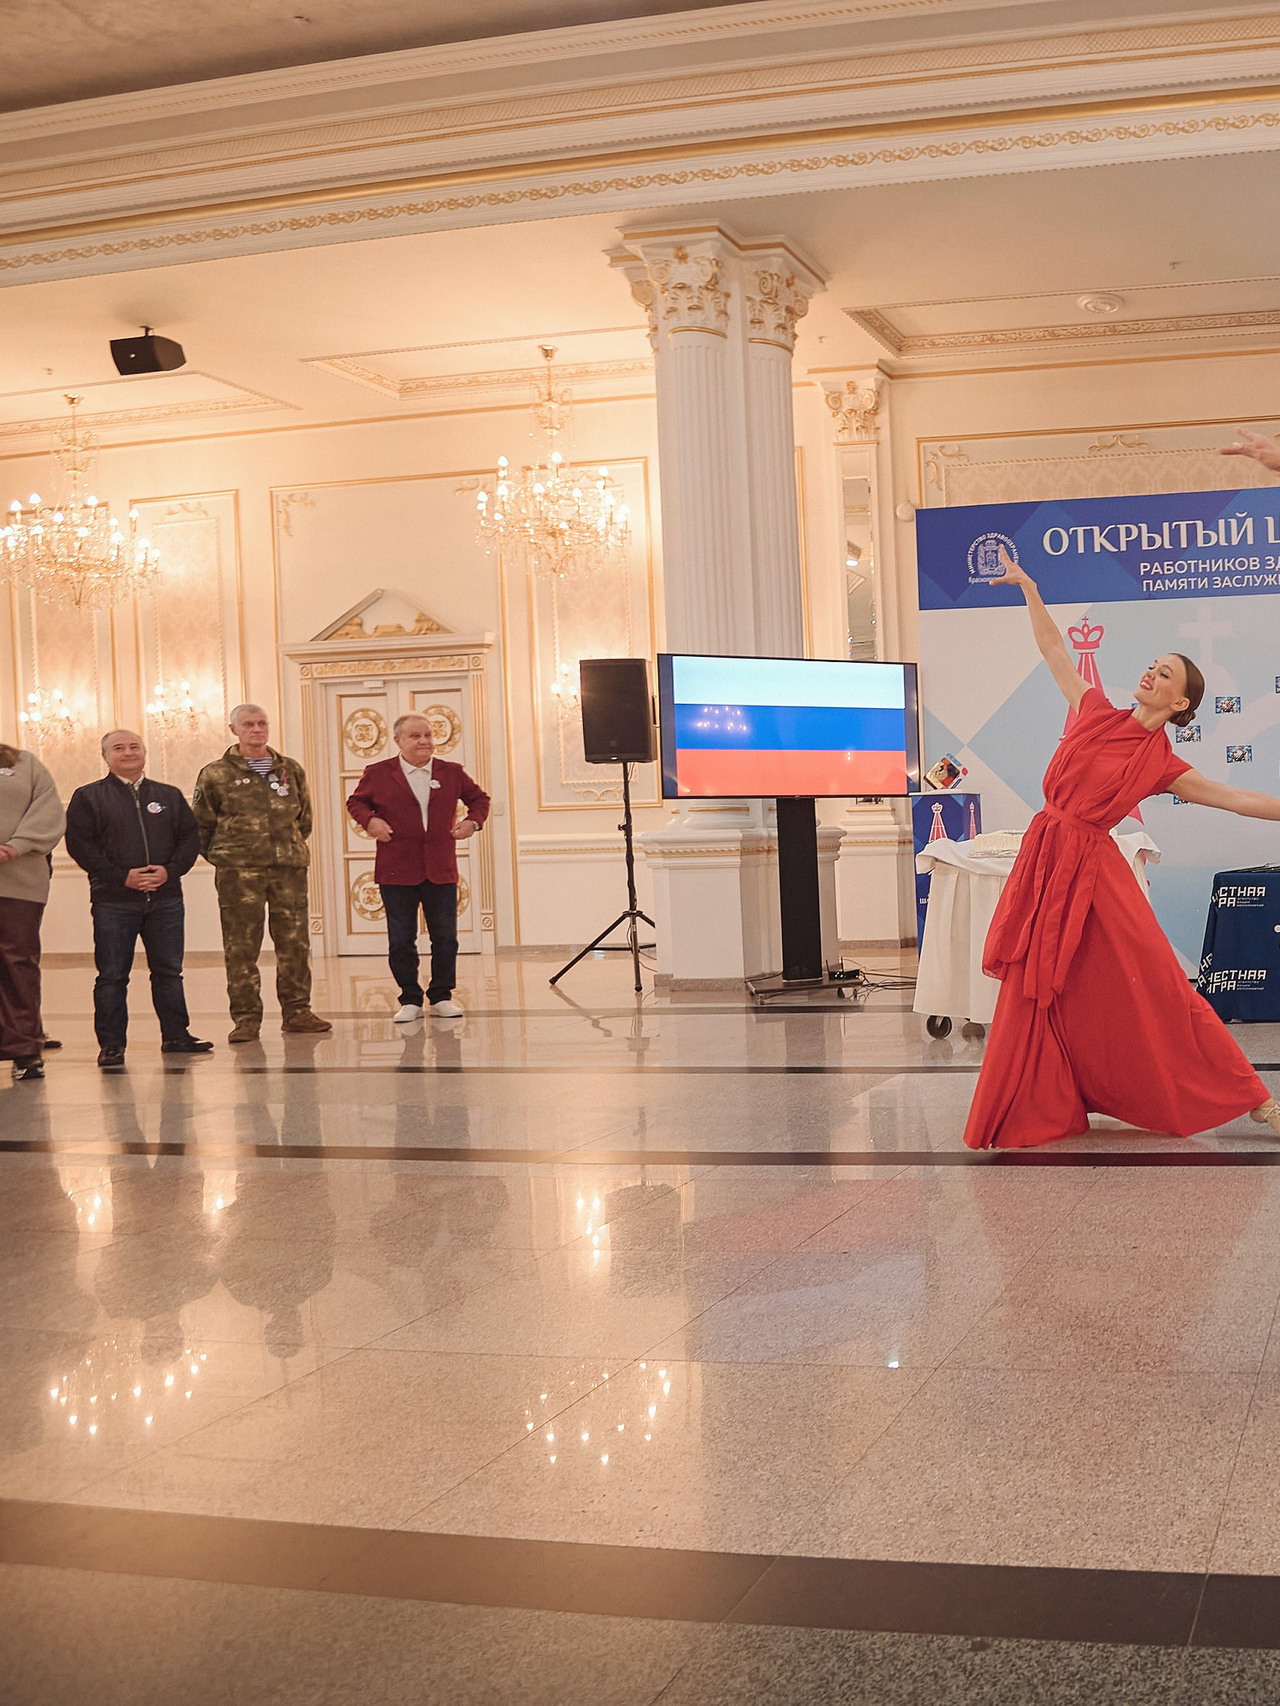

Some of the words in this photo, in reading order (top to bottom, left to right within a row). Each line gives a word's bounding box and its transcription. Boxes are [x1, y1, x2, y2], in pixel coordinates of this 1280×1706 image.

[1043, 511, 1255, 556] ОТКРЫТЫЙ
[1140, 555, 1261, 576] РАБОТНИКОВ
[1142, 577, 1209, 592] ПАМЯТИ
[1218, 897, 1237, 908] РА
[1208, 969, 1267, 983] ЧЕСТНАЯ
